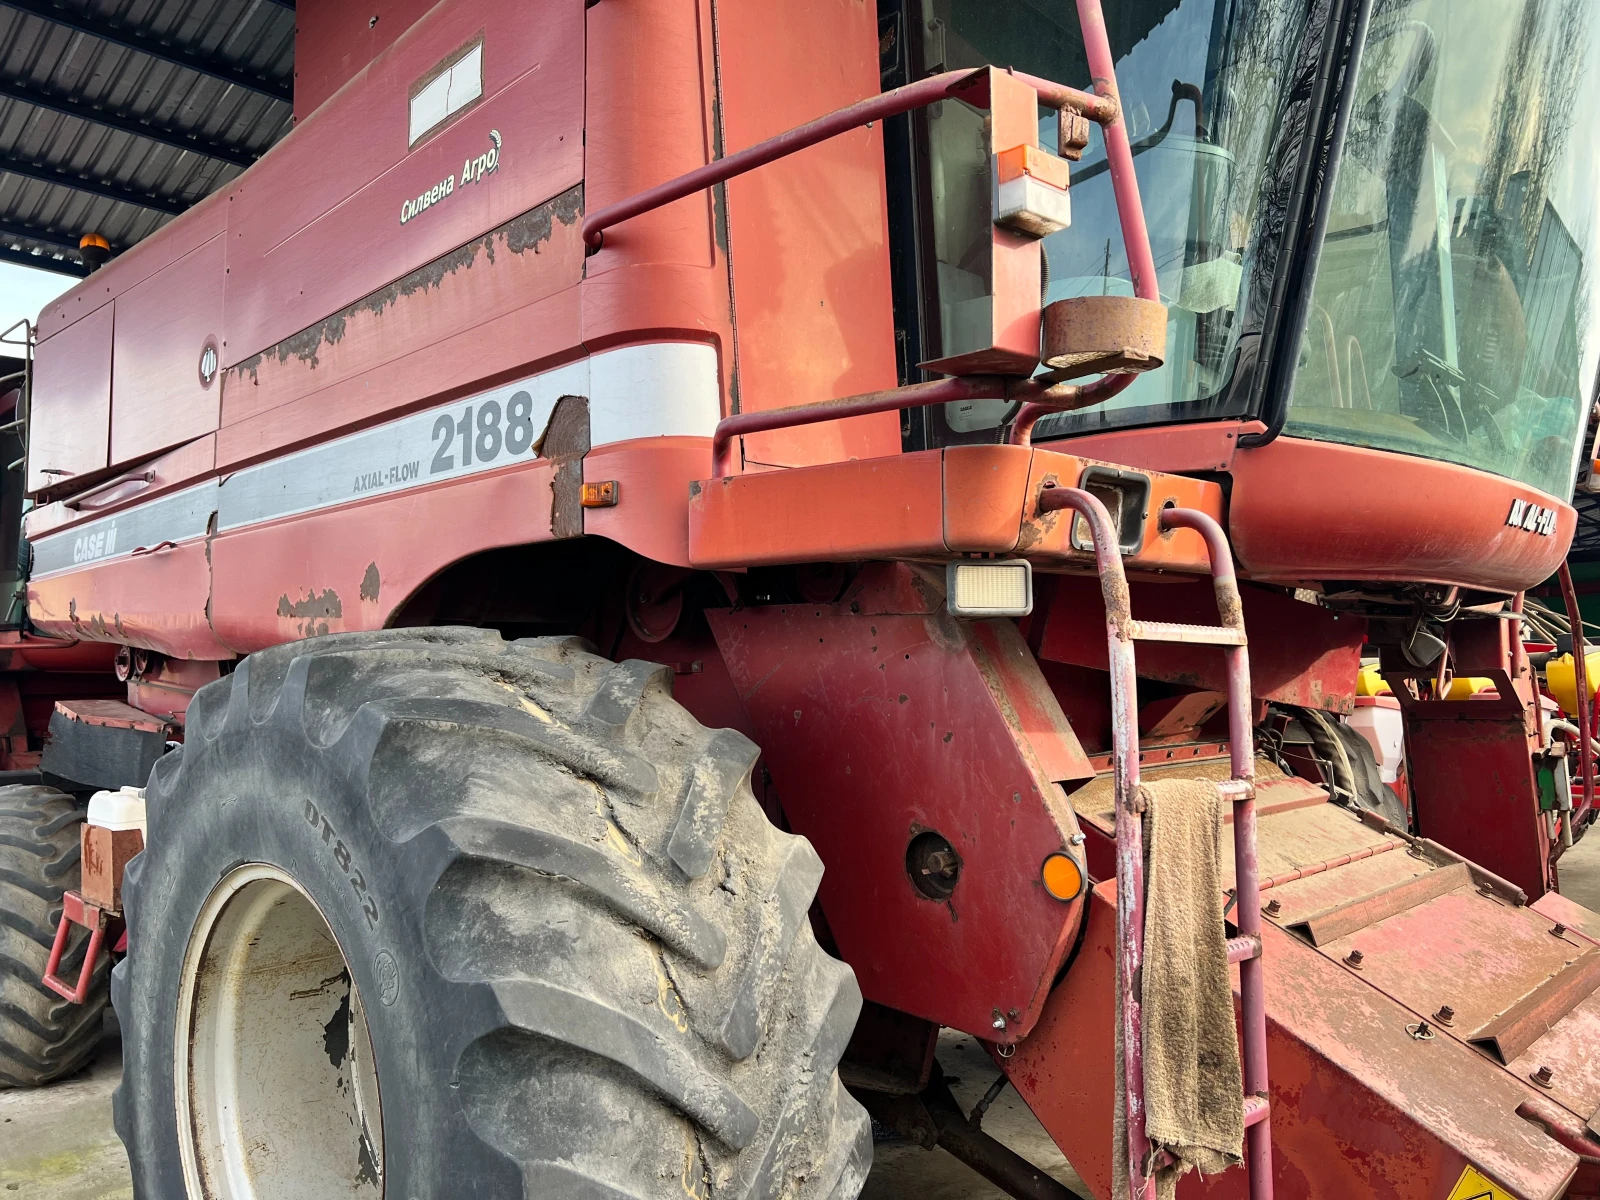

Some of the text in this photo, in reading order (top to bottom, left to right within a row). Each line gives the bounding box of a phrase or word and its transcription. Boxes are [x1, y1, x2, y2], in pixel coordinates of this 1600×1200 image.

[400, 147, 496, 224] Силвена Агро
[353, 390, 534, 493] AXIAL-FLOW 2188
[73, 532, 105, 564] CASE
[304, 798, 379, 932] DT822
